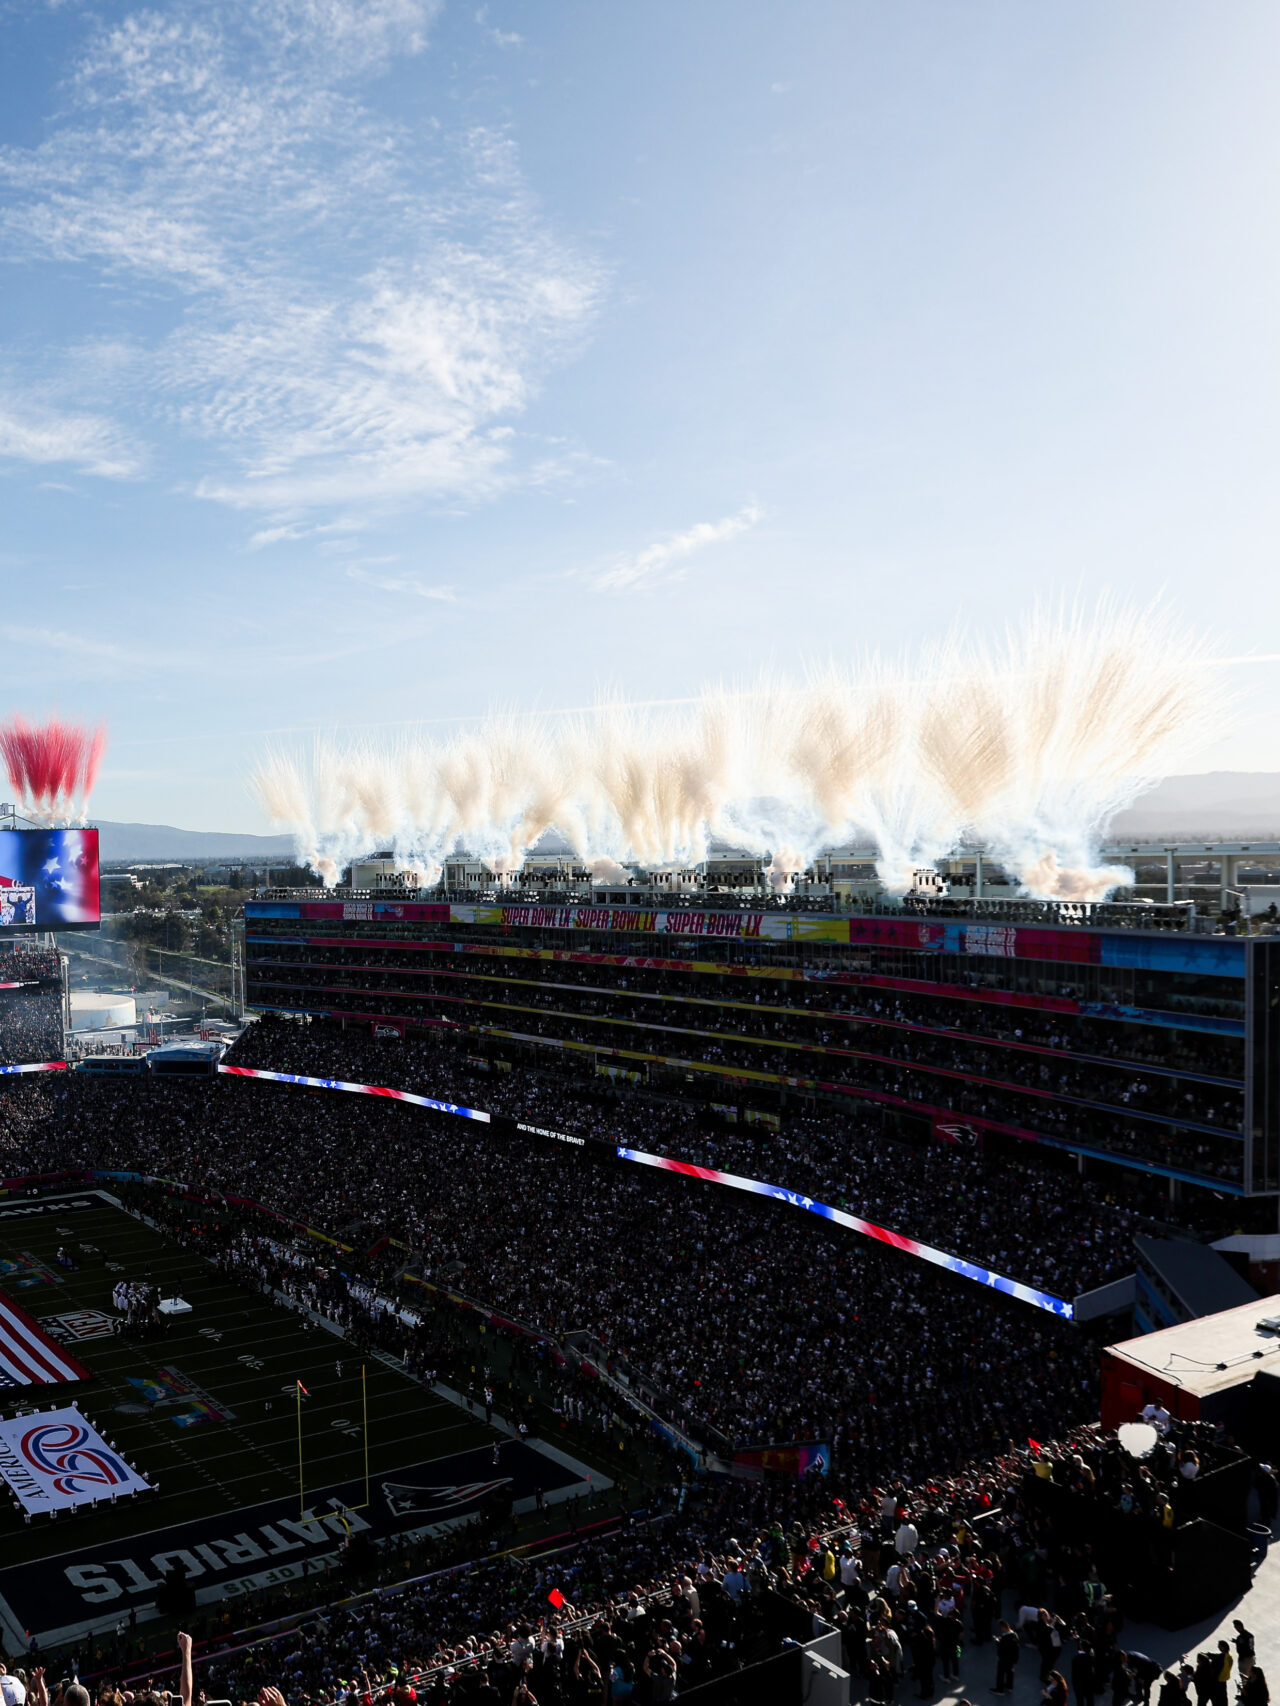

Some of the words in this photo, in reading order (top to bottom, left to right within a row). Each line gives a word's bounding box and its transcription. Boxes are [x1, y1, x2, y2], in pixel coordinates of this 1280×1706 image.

[501, 907, 529, 925] SUPER
[531, 908, 557, 927] BOWL
[558, 909, 571, 928] LX
[575, 910, 609, 929] SUPER
[611, 911, 642, 931] BOWL
[643, 912, 658, 932] LX
[665, 912, 706, 934] SUPER
[707, 914, 742, 936] BOWL
[744, 915, 763, 937] LX
[517, 1123, 526, 1131] AND
[536, 1128, 549, 1137] HOME
[63, 1313, 112, 1337] NFL
[63, 1497, 373, 1603] PATRIOTS
[223, 1578, 258, 1593] US
[266, 1567, 295, 1583] OF
